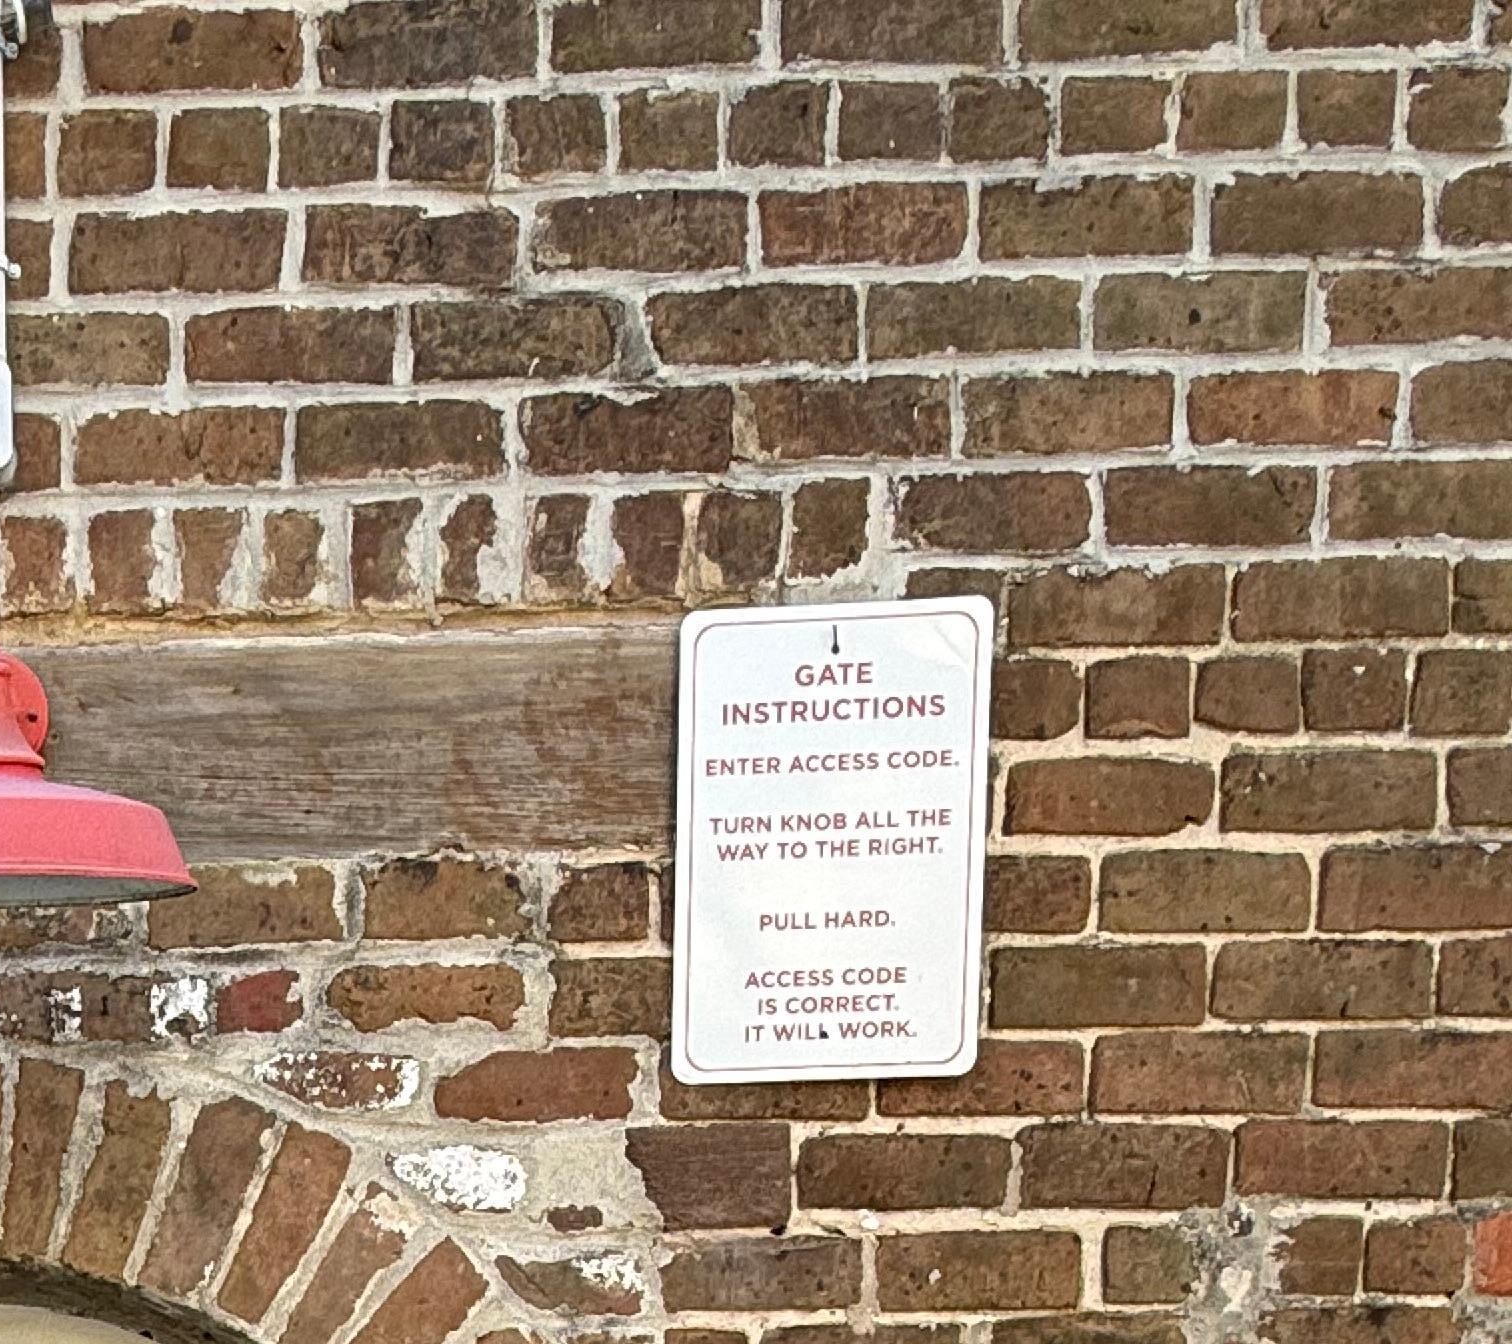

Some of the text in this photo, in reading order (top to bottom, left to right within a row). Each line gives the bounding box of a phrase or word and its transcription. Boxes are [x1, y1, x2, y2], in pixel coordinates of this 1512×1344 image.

[795, 662, 873, 687] GATE
[722, 695, 946, 726] INSTRUCTIONS
[706, 749, 960, 777] ENTER ACCESS CODE.
[709, 809, 952, 835] TURN KNOB ALL THE
[716, 836, 944, 861] WAY TO THE RIGHT.
[759, 910, 896, 931] PULL HARD.
[745, 967, 907, 989] ACCESS CODE
[758, 994, 900, 1016] IS CORRECT.
[745, 1020, 918, 1043] IT WILL WORK.
